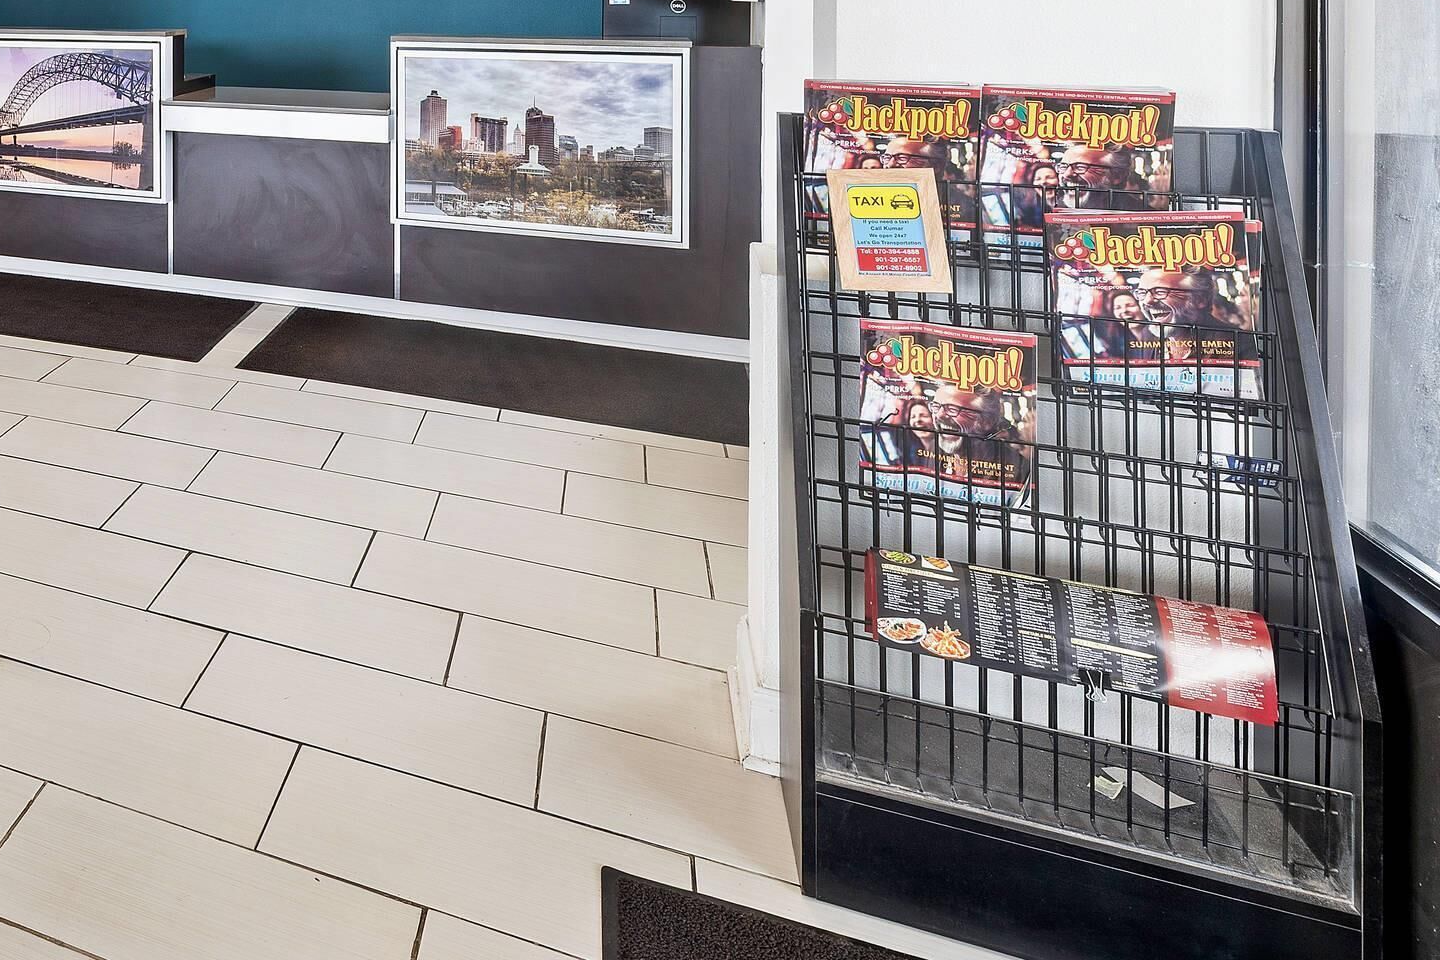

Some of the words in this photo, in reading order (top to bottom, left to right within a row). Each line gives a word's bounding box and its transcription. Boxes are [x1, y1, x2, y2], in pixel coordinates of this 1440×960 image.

[846, 95, 971, 143] Jackpot!
[1018, 100, 1160, 151] Jackpot!
[1006, 148, 1034, 156] PERKS
[852, 196, 884, 206] TAXI
[1088, 223, 1236, 274] Jackpot!
[1078, 276, 1108, 284] PERKS
[895, 335, 1024, 393] Jackpot!
